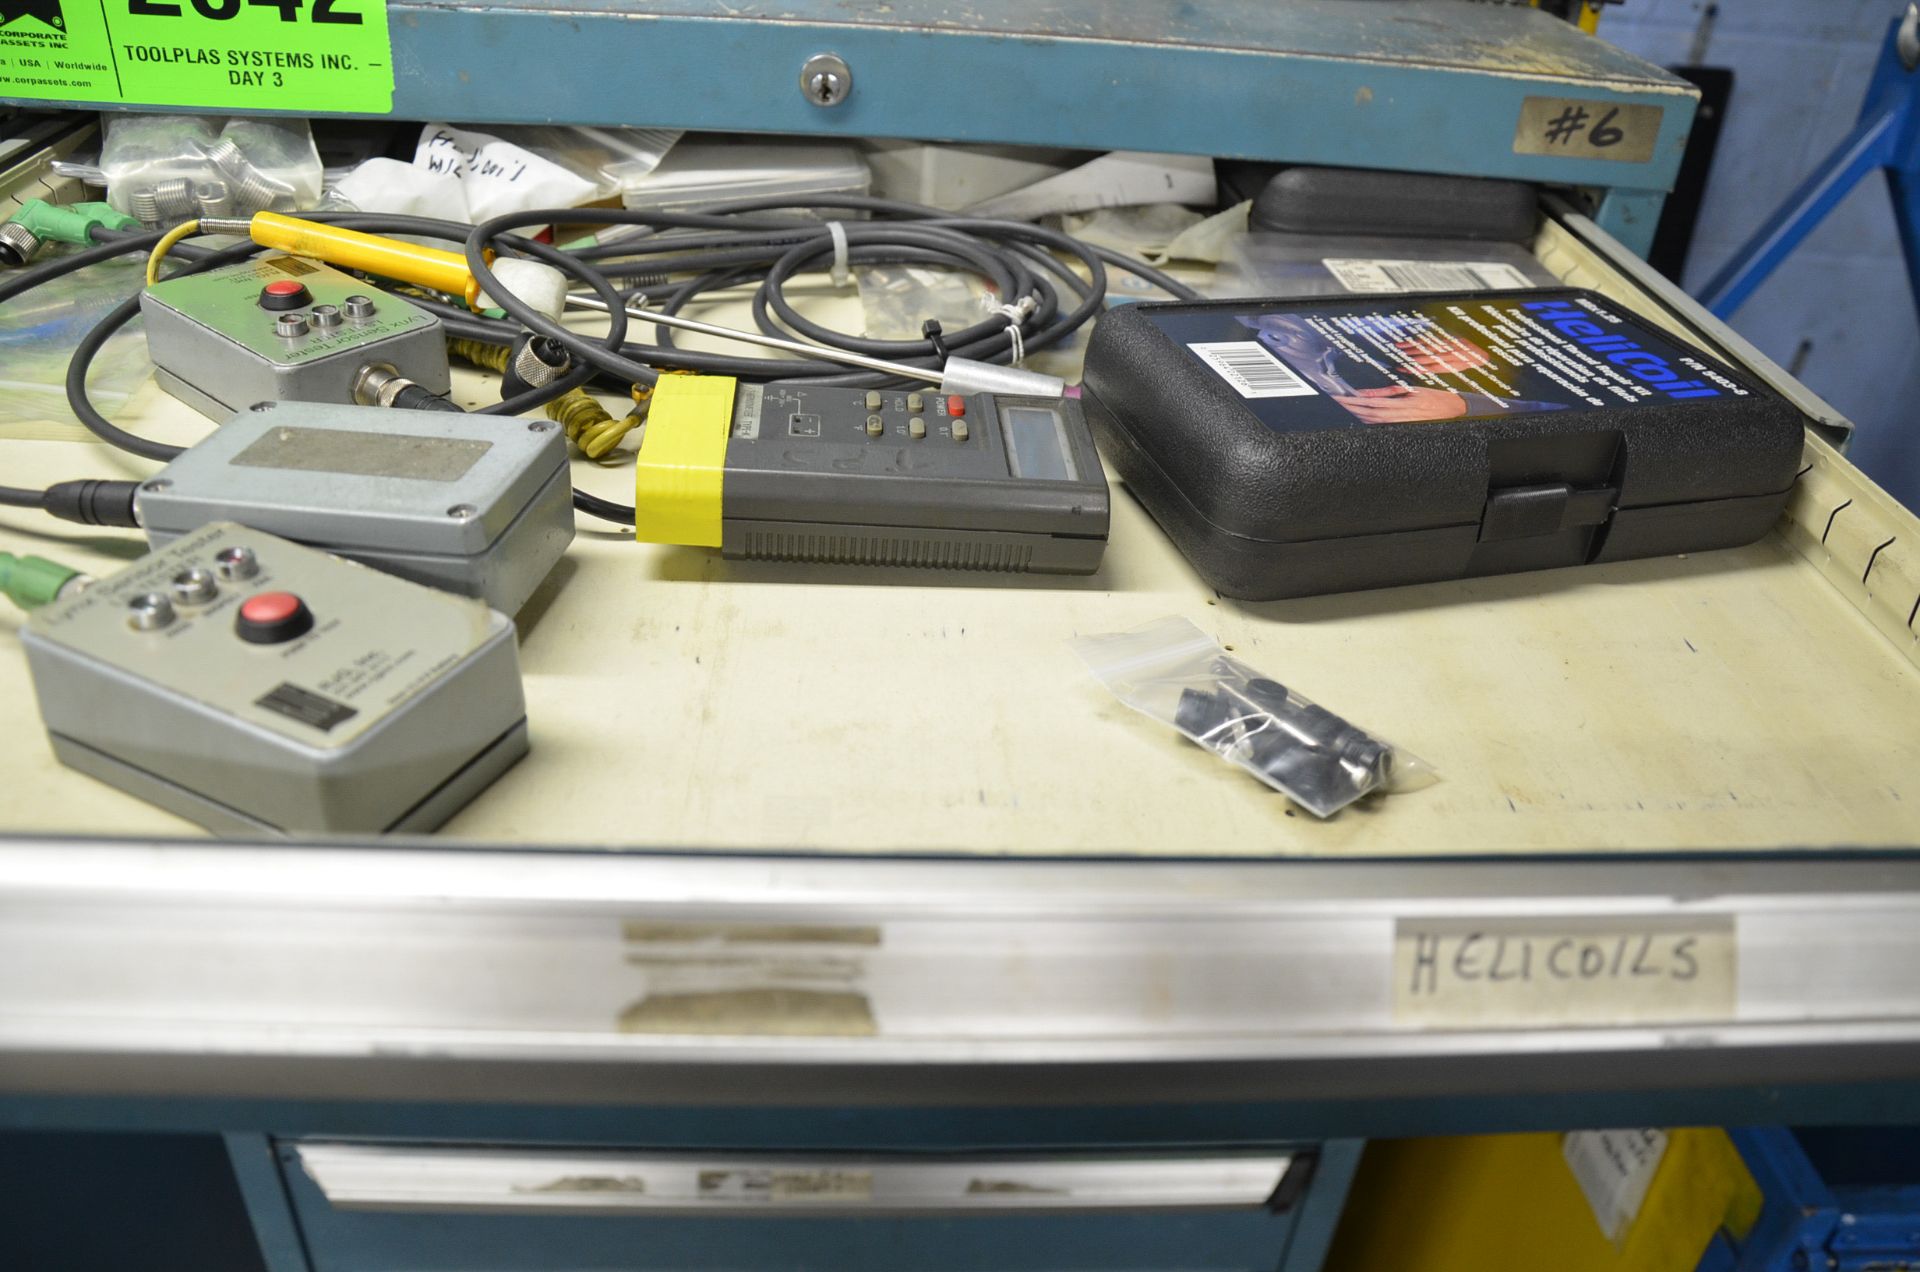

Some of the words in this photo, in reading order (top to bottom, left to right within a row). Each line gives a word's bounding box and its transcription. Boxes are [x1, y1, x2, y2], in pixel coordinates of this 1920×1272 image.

[1, 39, 45, 48] ASSETS
[49, 41, 68, 49] INC
[19, 58, 41, 68] USA
[54, 60, 107, 71] Worldwide
[124, 45, 221, 65] TOOLPLAS
[228, 49, 314, 69] SYSTEMS
[321, 54, 359, 71] INC.
[229, 70, 264, 87] DAY
[273, 71, 284, 87] 3
[1545, 106, 1624, 148] #6
[386, 313, 429, 329] Lynx
[1442, 306, 1469, 315] Kit
[332, 325, 392, 345] Sensor
[1454, 315, 1519, 348] profesional
[280, 342, 335, 360] Tester
[1484, 345, 1529, 366] roscas
[1488, 324, 1523, 339] pour
[1512, 339, 1595, 383] professionnels
[1501, 308, 1571, 344] Professional
[1559, 344, 1603, 365] Thread
[1590, 364, 1637, 385] Repair
[1627, 385, 1655, 395] Kit
[1504, 348, 1538, 363] para
[1525, 337, 1549, 345] de
[1537, 345, 1599, 376] réparation
[1589, 376, 1614, 385] de
[1604, 385, 1642, 402] filets
[1526, 363, 1593, 396] reparación
[1676, 357, 1709, 370] P/N
[1698, 370, 1751, 395] 5403-8
[936, 397, 947, 417] POWER
[1582, 396, 1608, 406] de
[166, 526, 231, 557] Tester
[1411, 929, 1701, 997] HELICOILS
